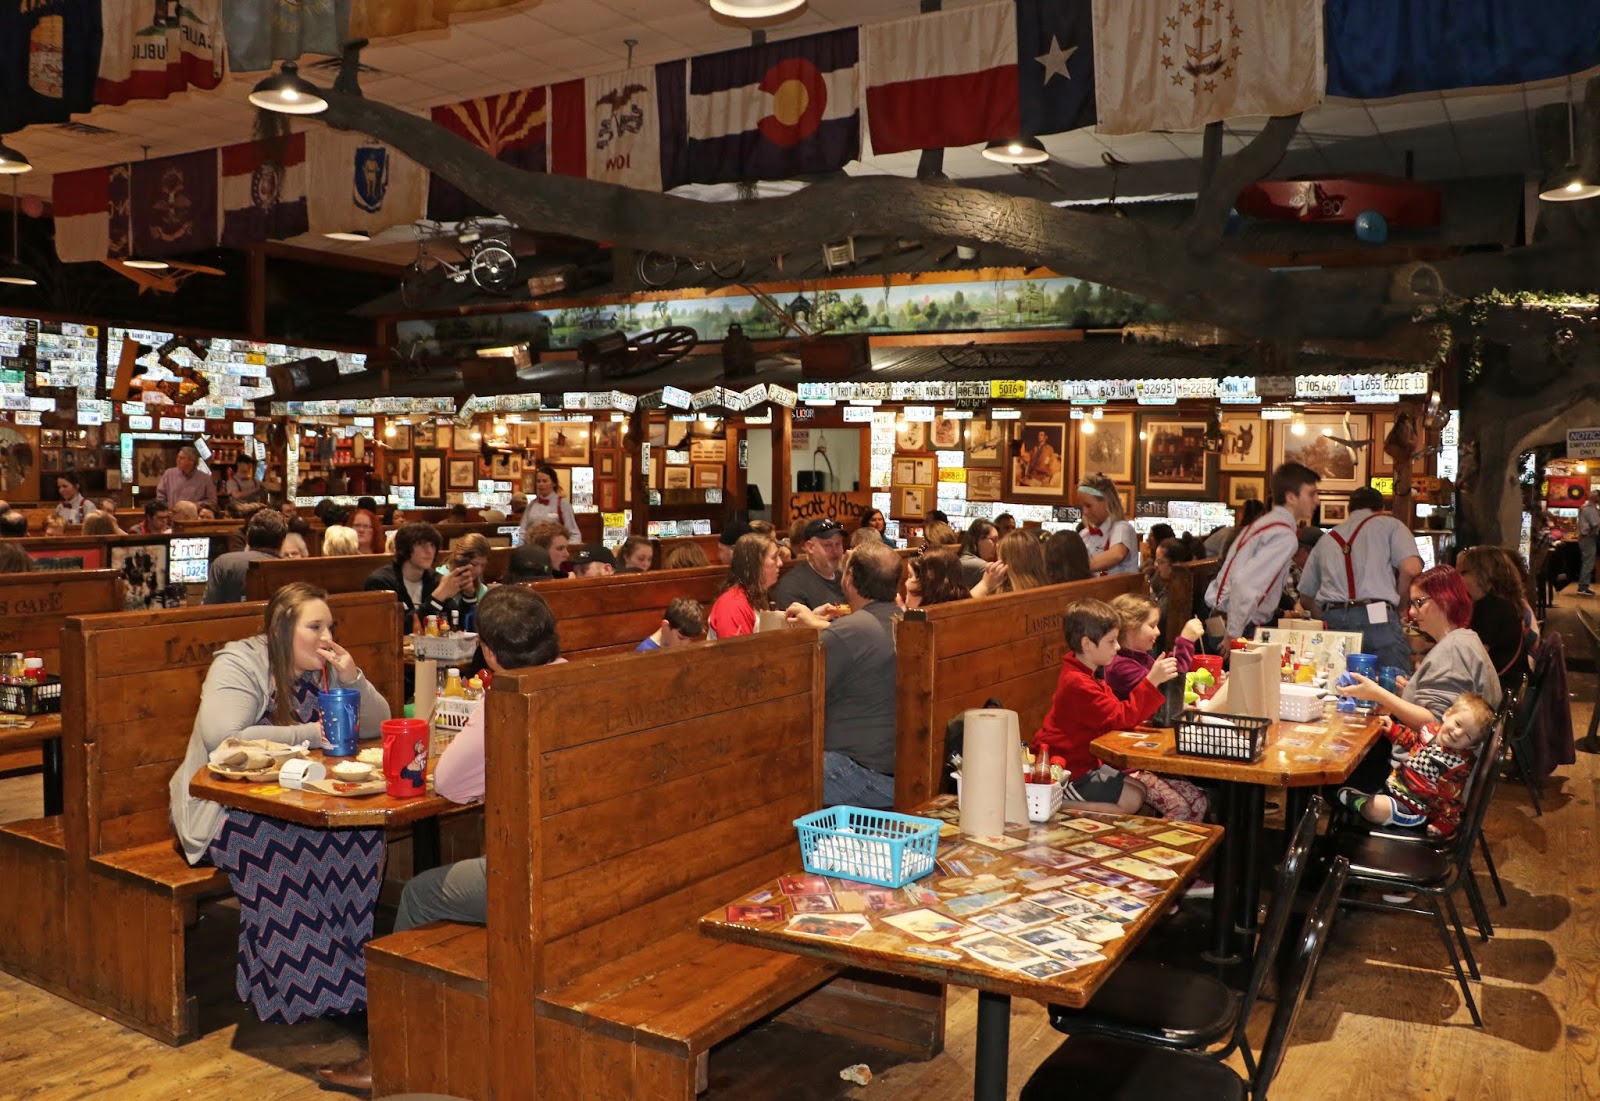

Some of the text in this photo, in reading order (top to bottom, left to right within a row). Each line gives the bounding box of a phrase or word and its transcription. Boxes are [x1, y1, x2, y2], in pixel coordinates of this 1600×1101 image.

[999, 384, 1018, 394] 5076
[1144, 383, 1172, 395] 32995
[1304, 380, 1320, 392] 705
[1321, 380, 1337, 392] 469
[1360, 379, 1381, 391] 1655
[790, 493, 825, 520] Scott
